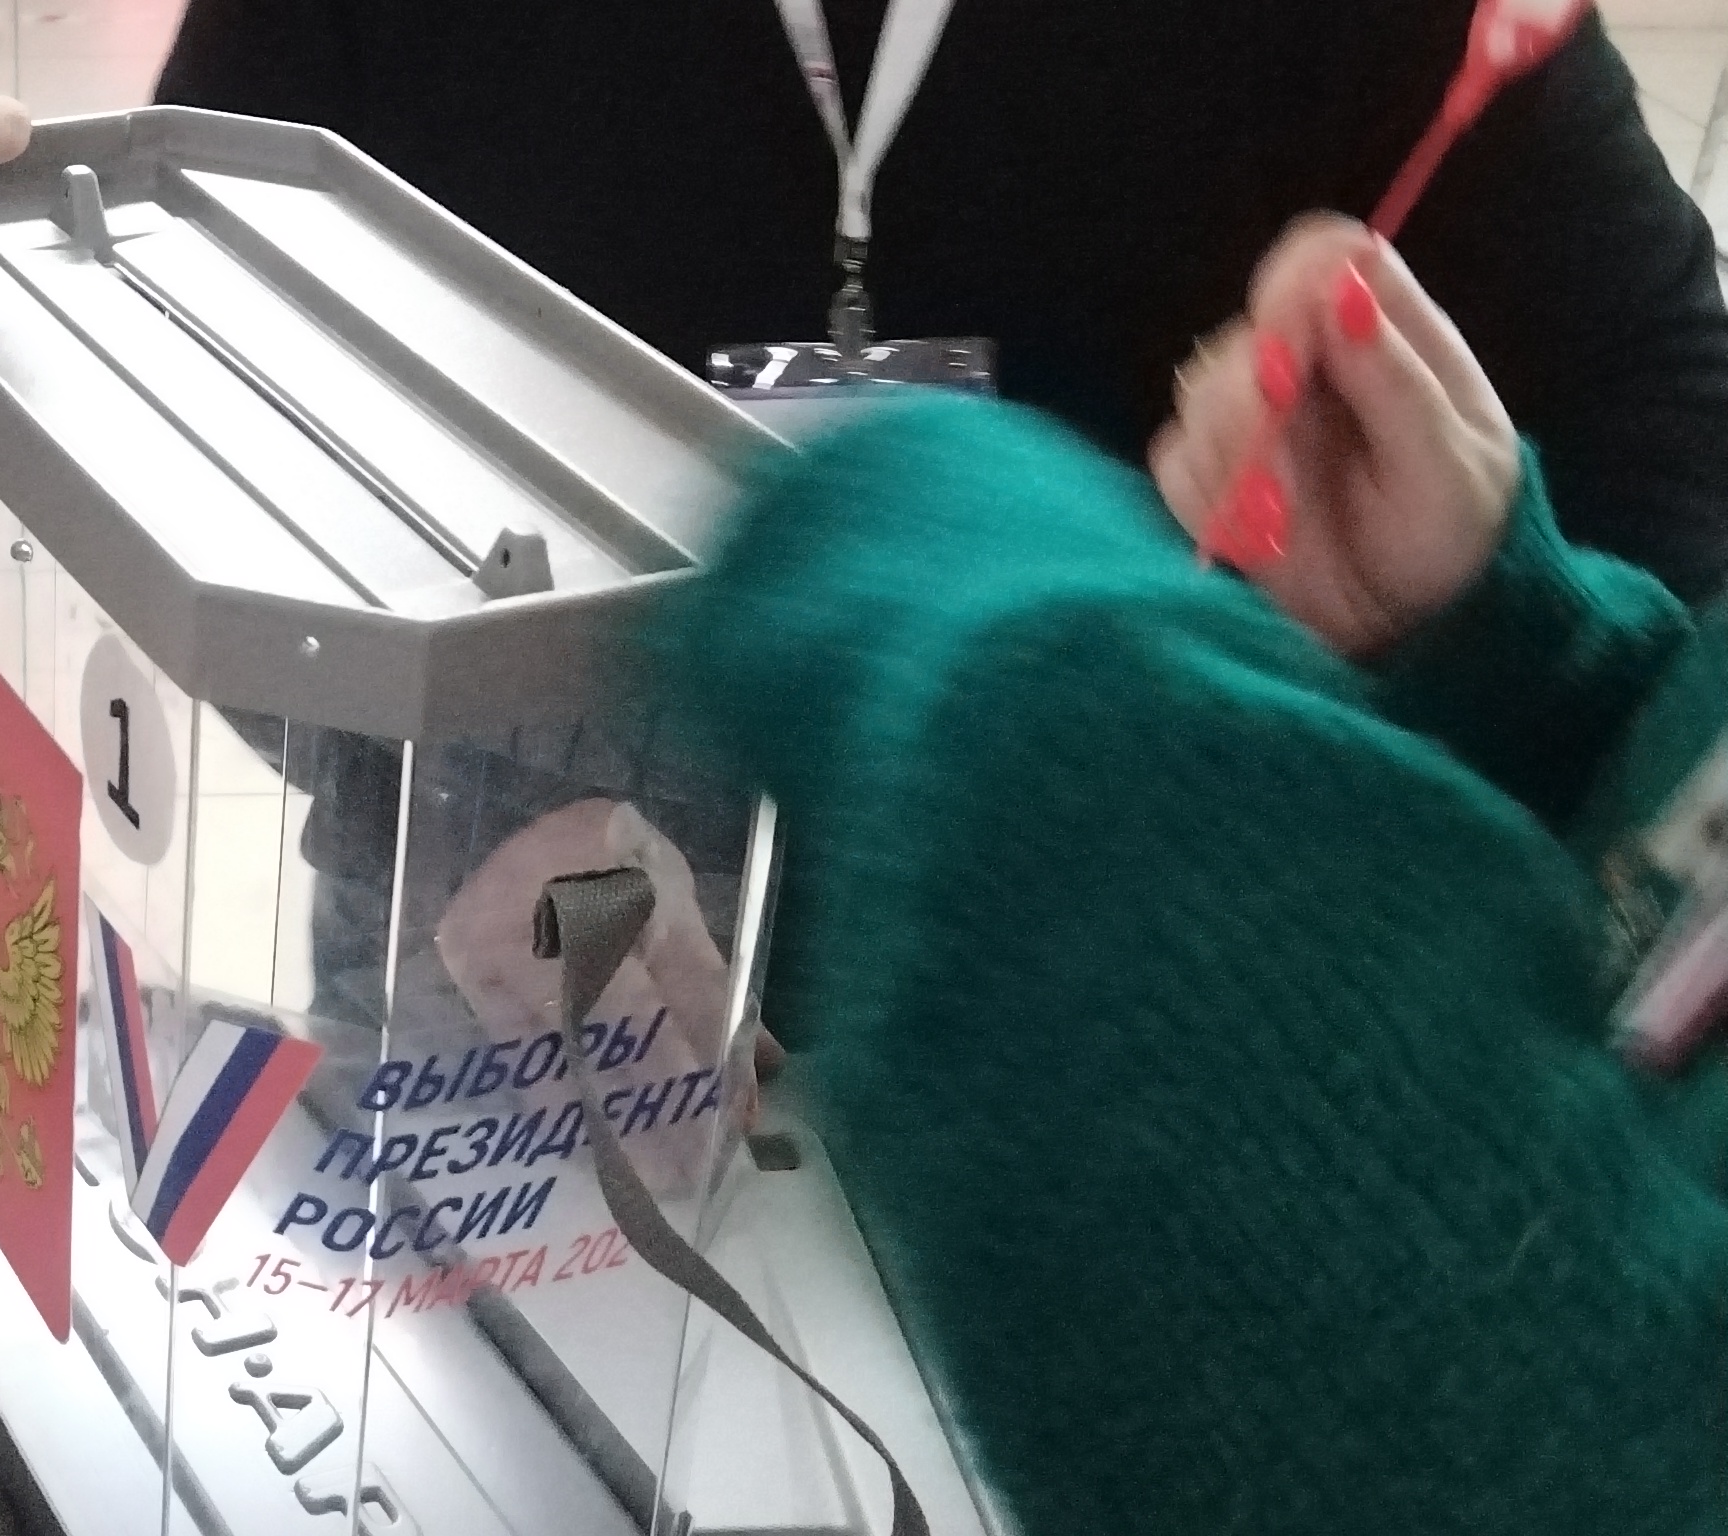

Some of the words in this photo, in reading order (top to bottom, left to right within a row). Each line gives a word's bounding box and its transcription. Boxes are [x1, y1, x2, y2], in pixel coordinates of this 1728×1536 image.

[107, 697, 140, 830] 1
[357, 1006, 669, 1113] ВЫБОРЫ
[273, 1175, 558, 1260] РОССИИ
[384, 1244, 548, 1319] МАРТА
